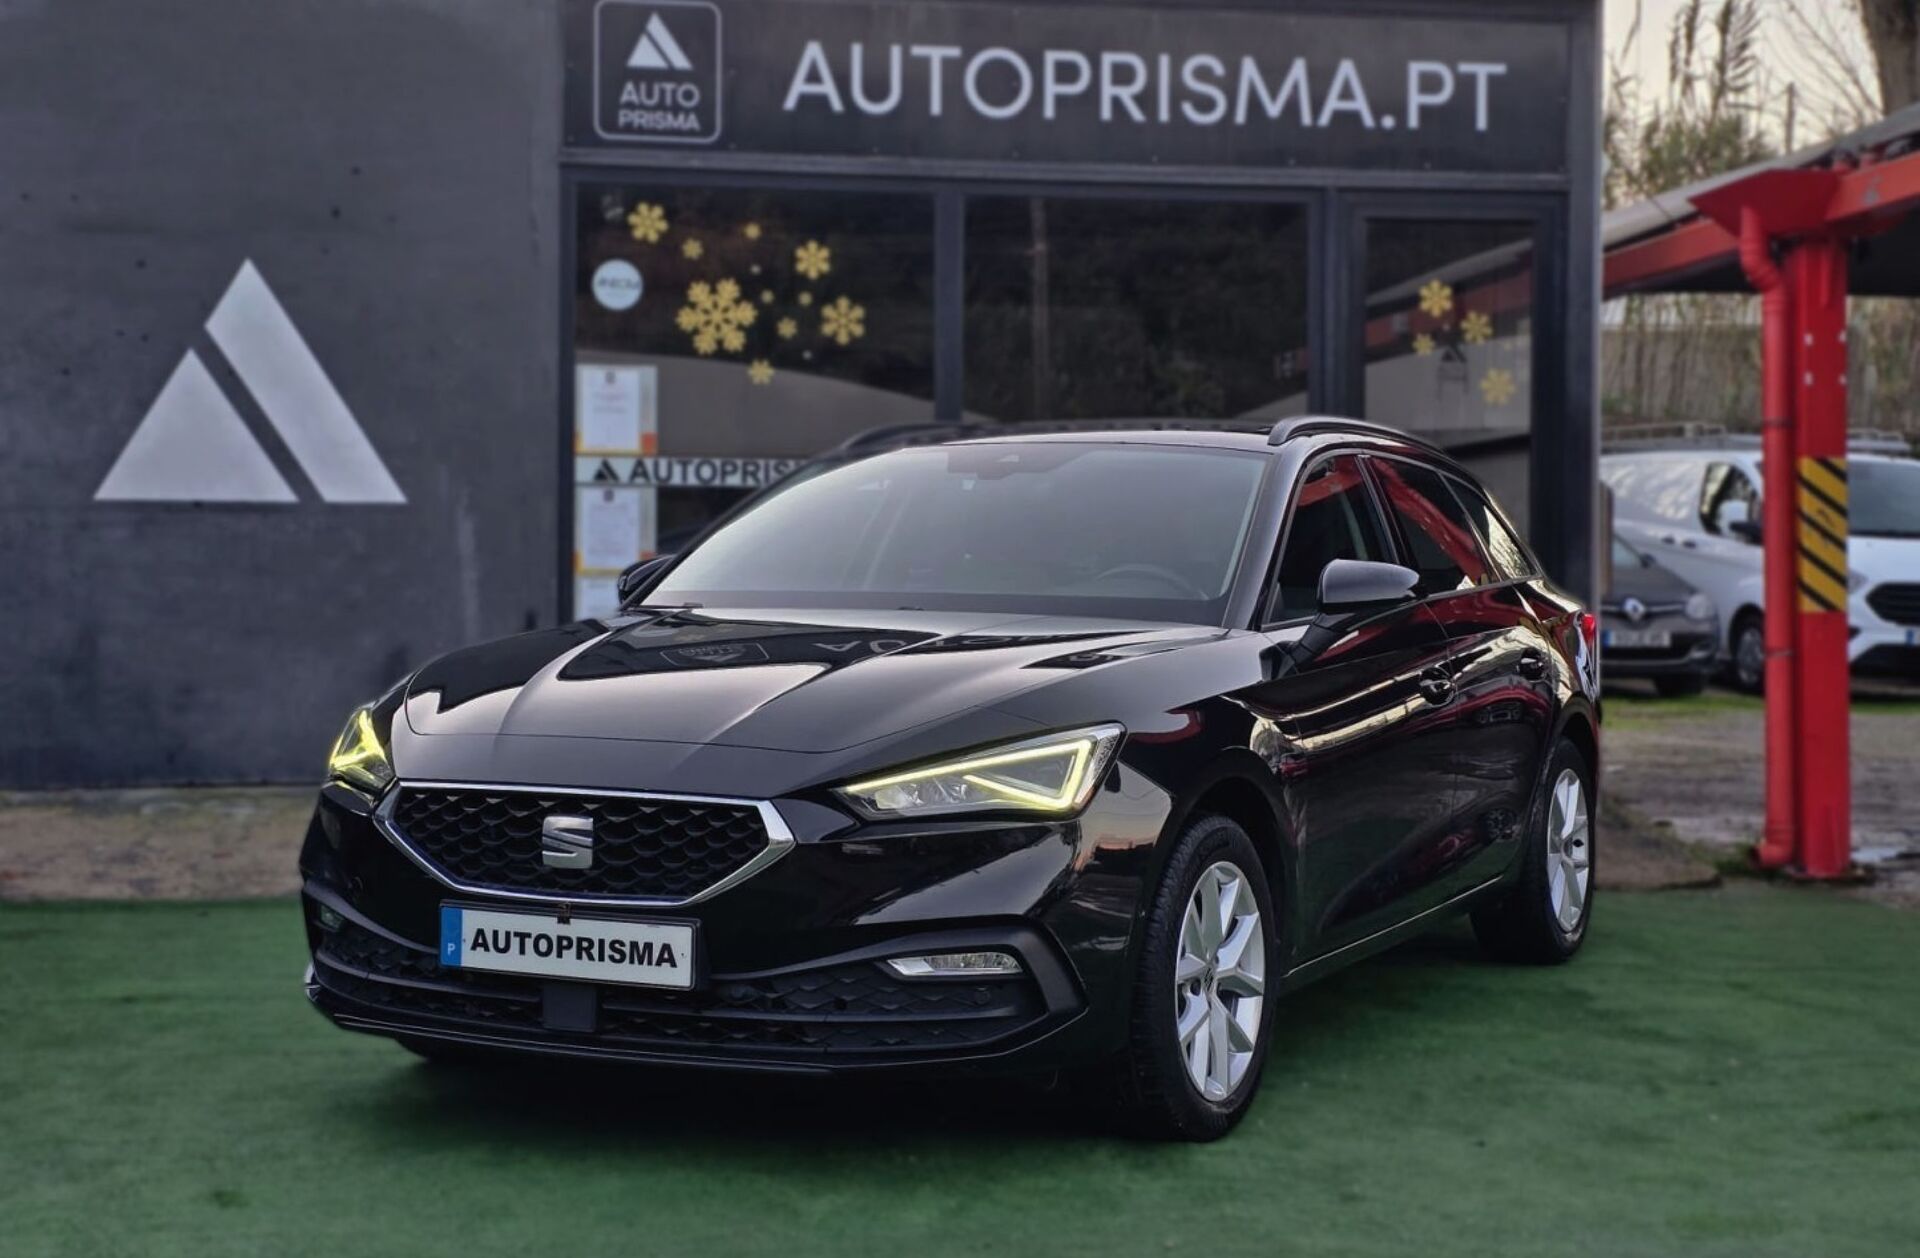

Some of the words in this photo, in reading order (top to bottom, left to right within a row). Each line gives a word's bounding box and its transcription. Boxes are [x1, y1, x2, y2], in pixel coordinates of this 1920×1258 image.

[620, 81, 700, 107] AUTO
[784, 40, 1507, 132] AUTOPRISMA.PT
[618, 109, 701, 131] PRISMA
[629, 459, 797, 485] AUTOPRIS
[446, 943, 457, 956] P
[470, 928, 678, 968] AUTOPRISMA
